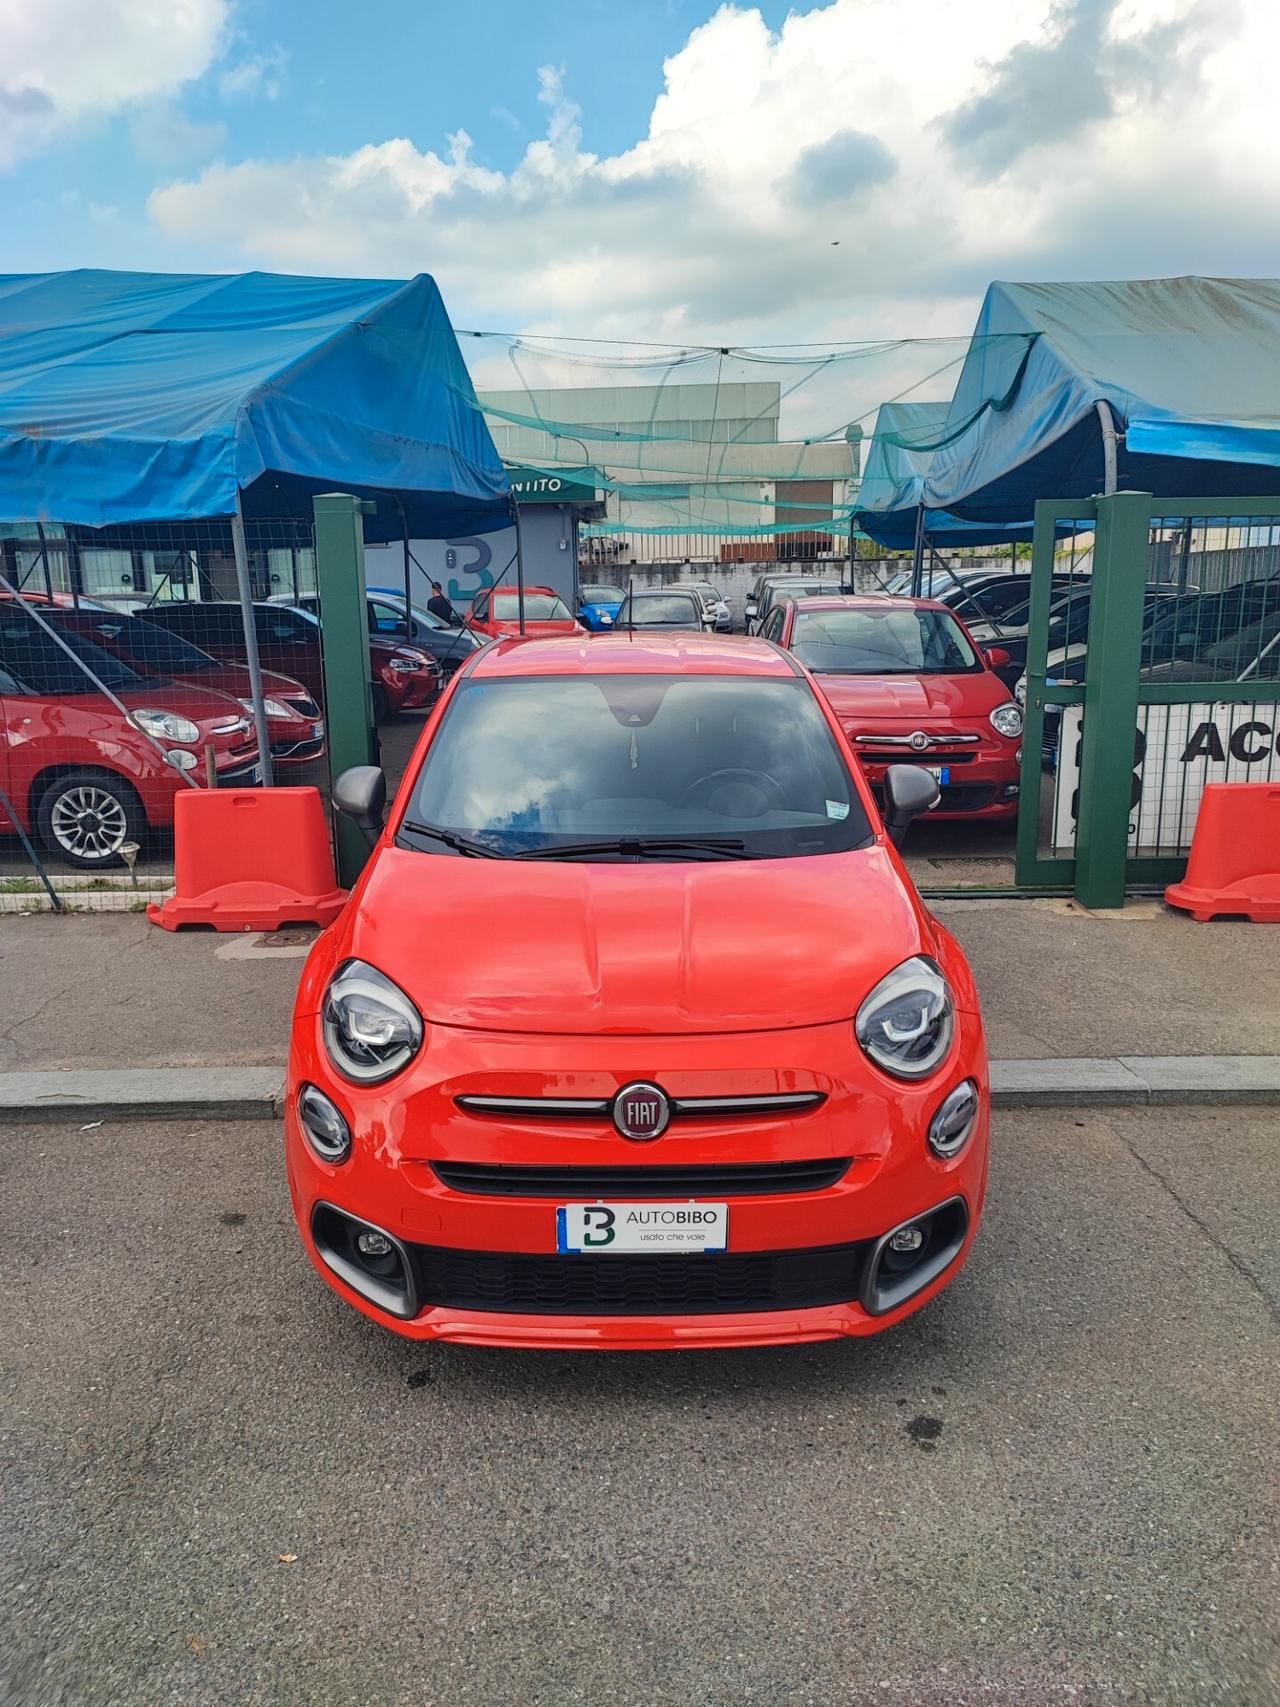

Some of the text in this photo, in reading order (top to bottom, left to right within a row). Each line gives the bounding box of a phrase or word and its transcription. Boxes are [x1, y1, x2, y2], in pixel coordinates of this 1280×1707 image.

[1179, 721, 1280, 763] AC
[627, 1102, 658, 1125] FIAT
[626, 1210, 718, 1225] AUTOBIBO
[640, 1231, 706, 1241] usato che vale
